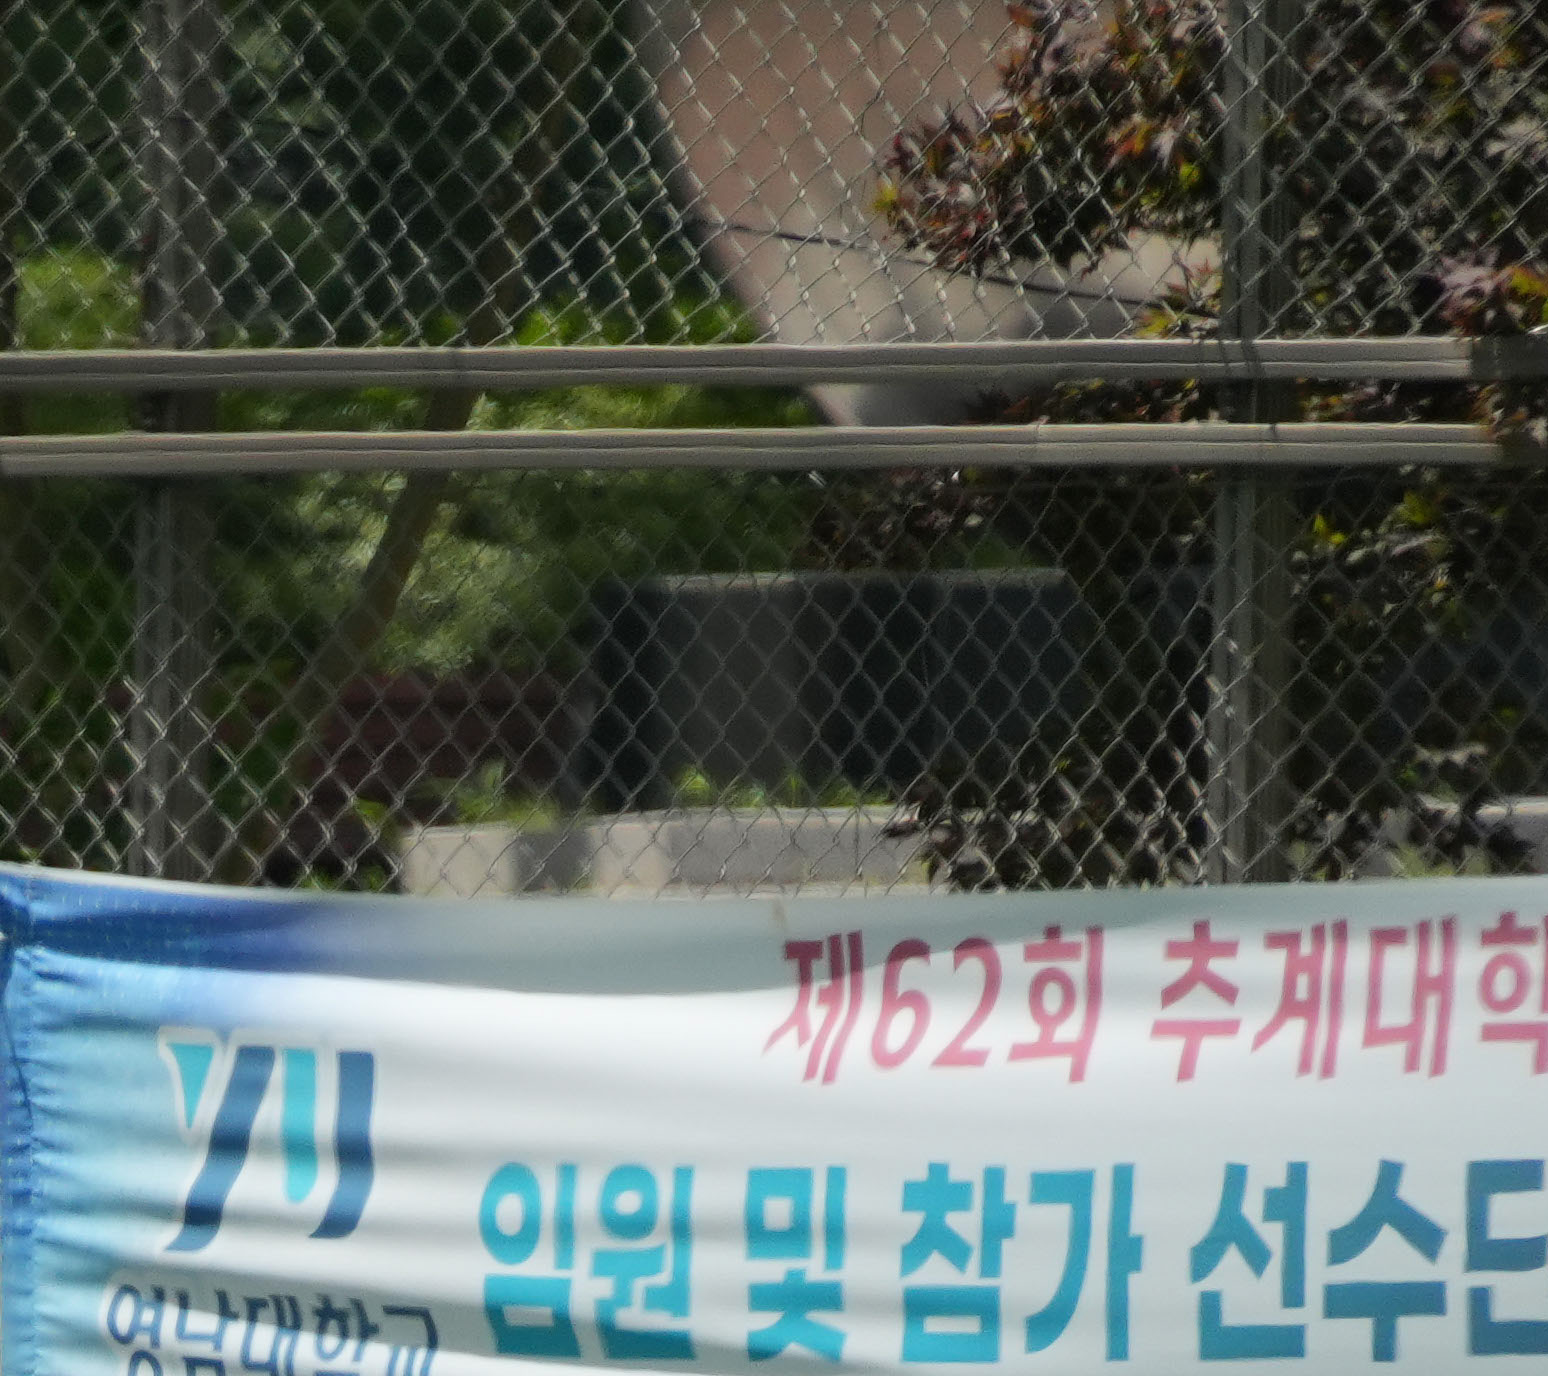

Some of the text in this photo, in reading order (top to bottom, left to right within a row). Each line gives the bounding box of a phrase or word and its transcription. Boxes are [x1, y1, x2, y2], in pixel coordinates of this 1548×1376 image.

[763, 924, 1104, 1085] 제62회
[479, 1161, 696, 1361] 임원
[745, 1165, 847, 1362] 및
[900, 1161, 1144, 1363] 참가
